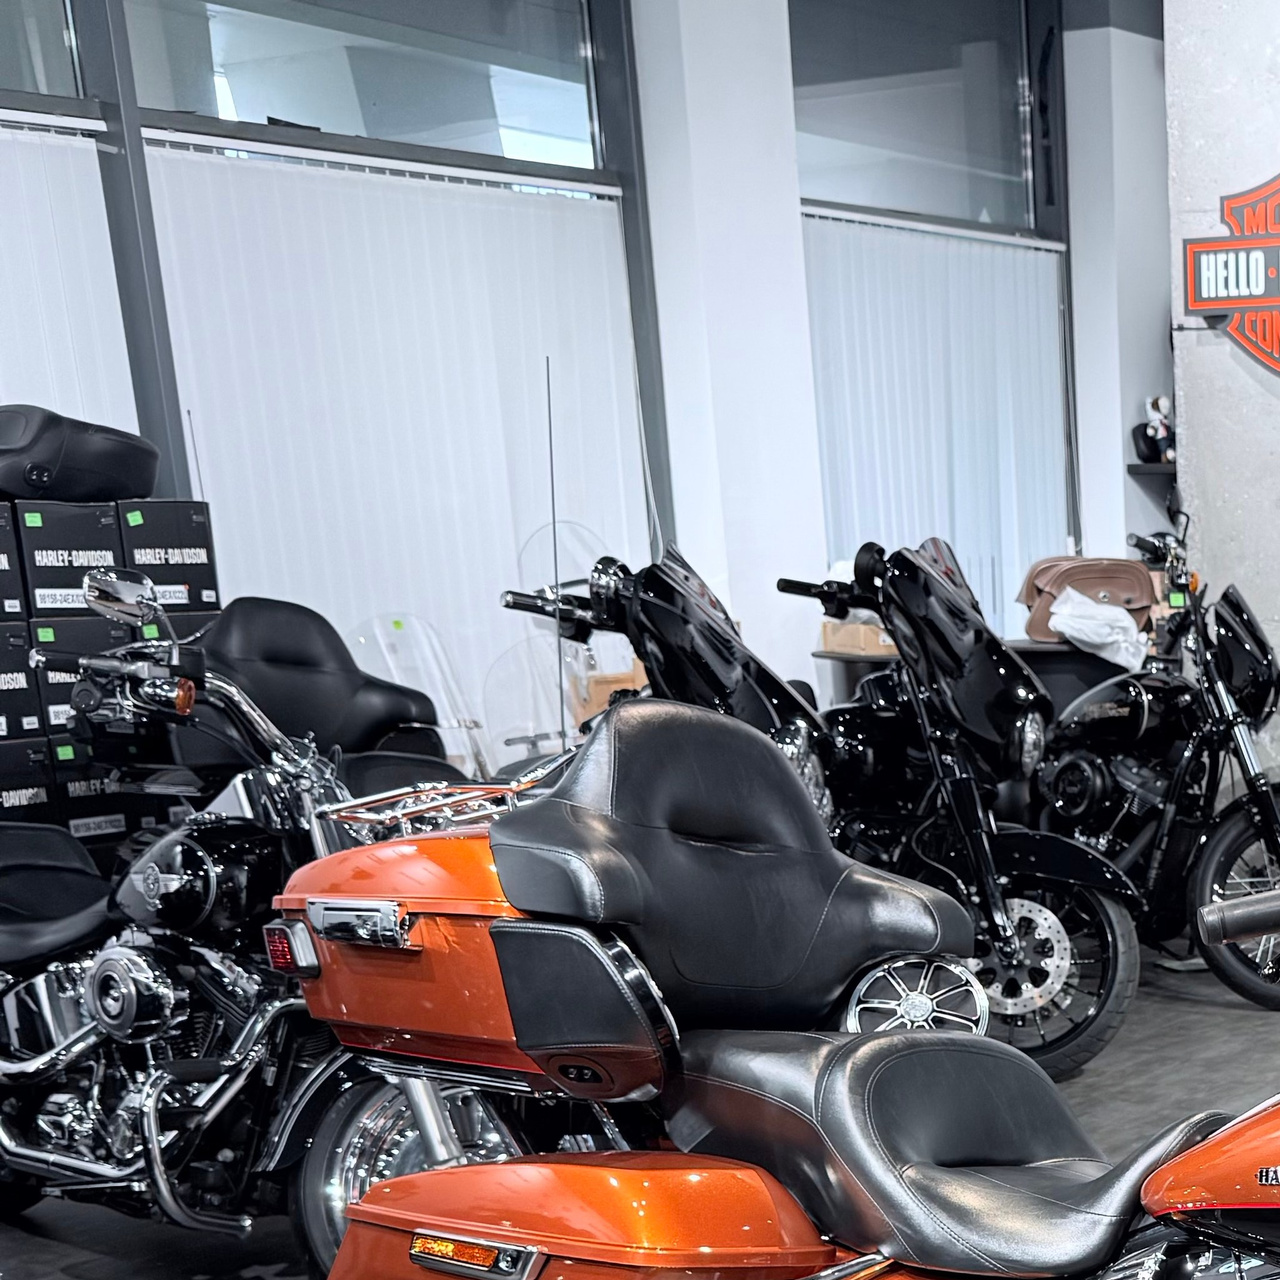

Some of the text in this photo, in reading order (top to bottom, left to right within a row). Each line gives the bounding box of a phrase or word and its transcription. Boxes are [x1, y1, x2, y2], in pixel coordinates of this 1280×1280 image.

[1200, 250, 1265, 299] HELLO
[34, 550, 115, 567] HARLEY-DAVIDSON
[133, 547, 209, 565] HARLEY-DAVIDSON
[0, 787, 48, 808] -DAVIDSON
